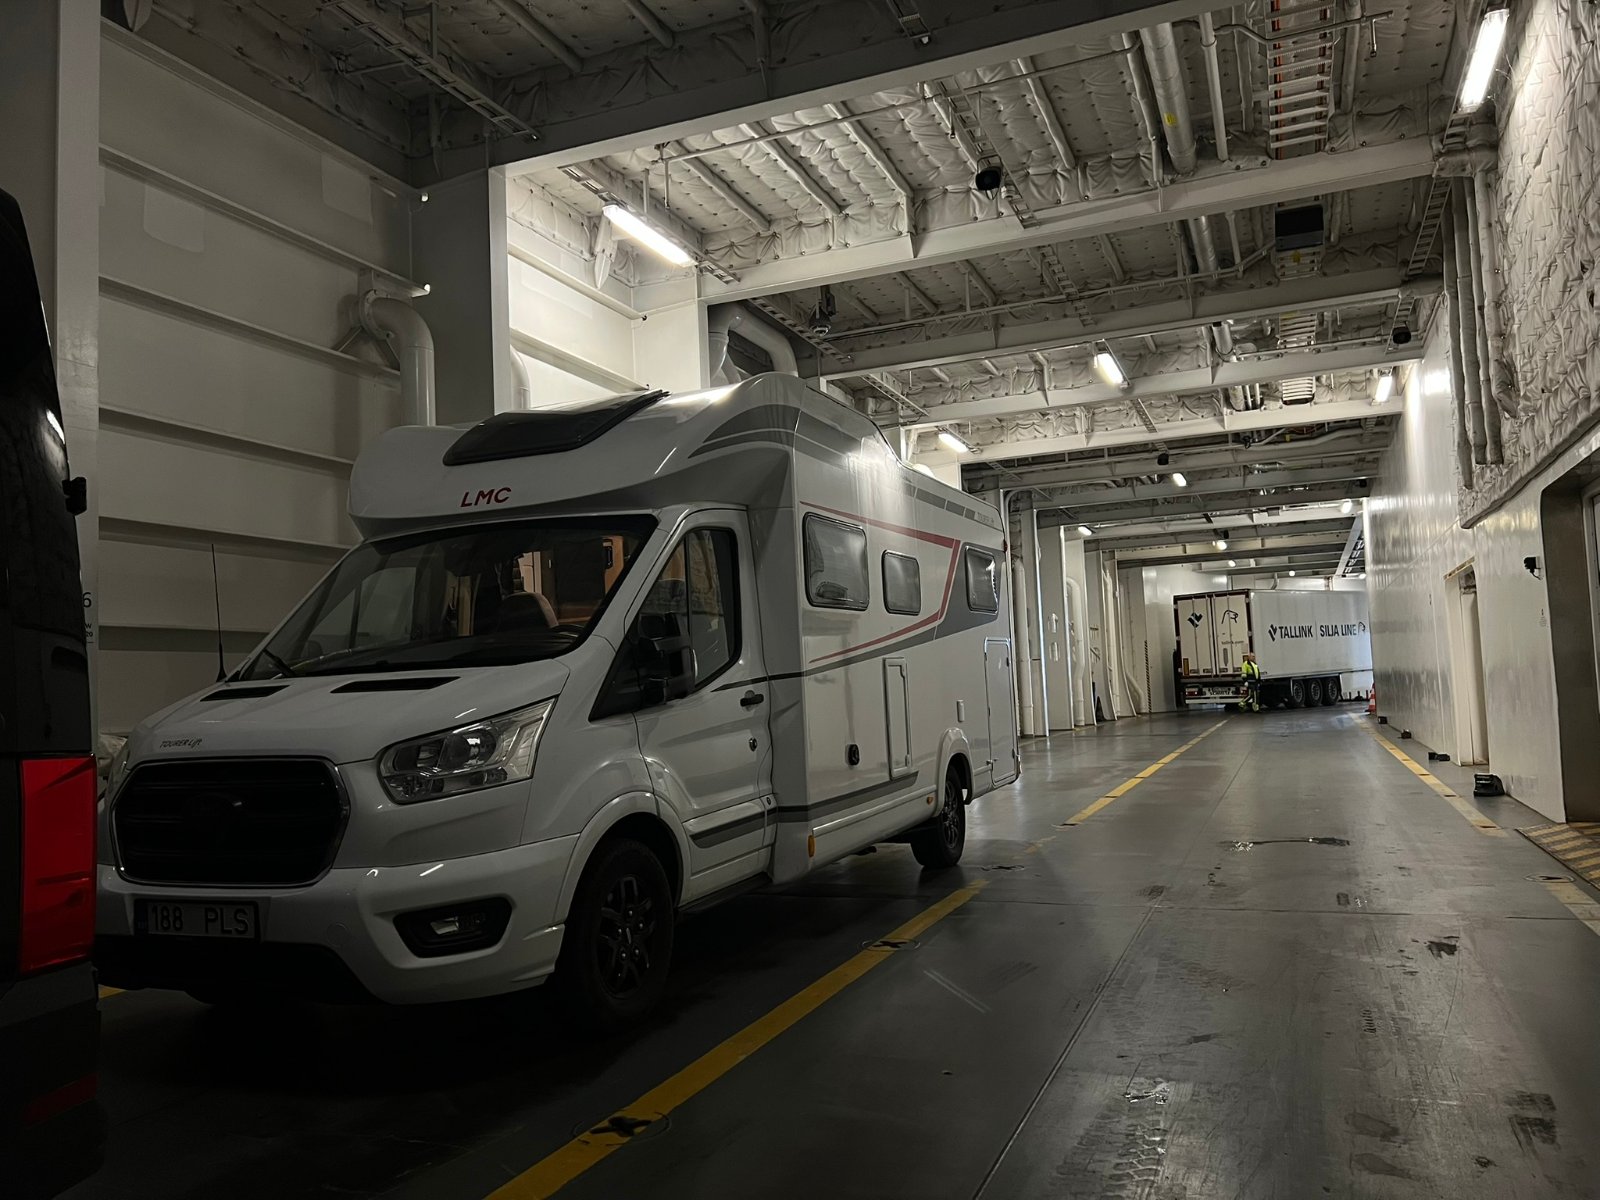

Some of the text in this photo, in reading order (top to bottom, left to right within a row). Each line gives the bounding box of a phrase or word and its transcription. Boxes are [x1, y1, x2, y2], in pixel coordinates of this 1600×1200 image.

[460, 486, 512, 508] LMC
[1278, 624, 1313, 639] TALLINK
[1340, 624, 1357, 637] LINE
[151, 905, 249, 935] 188 PLS
